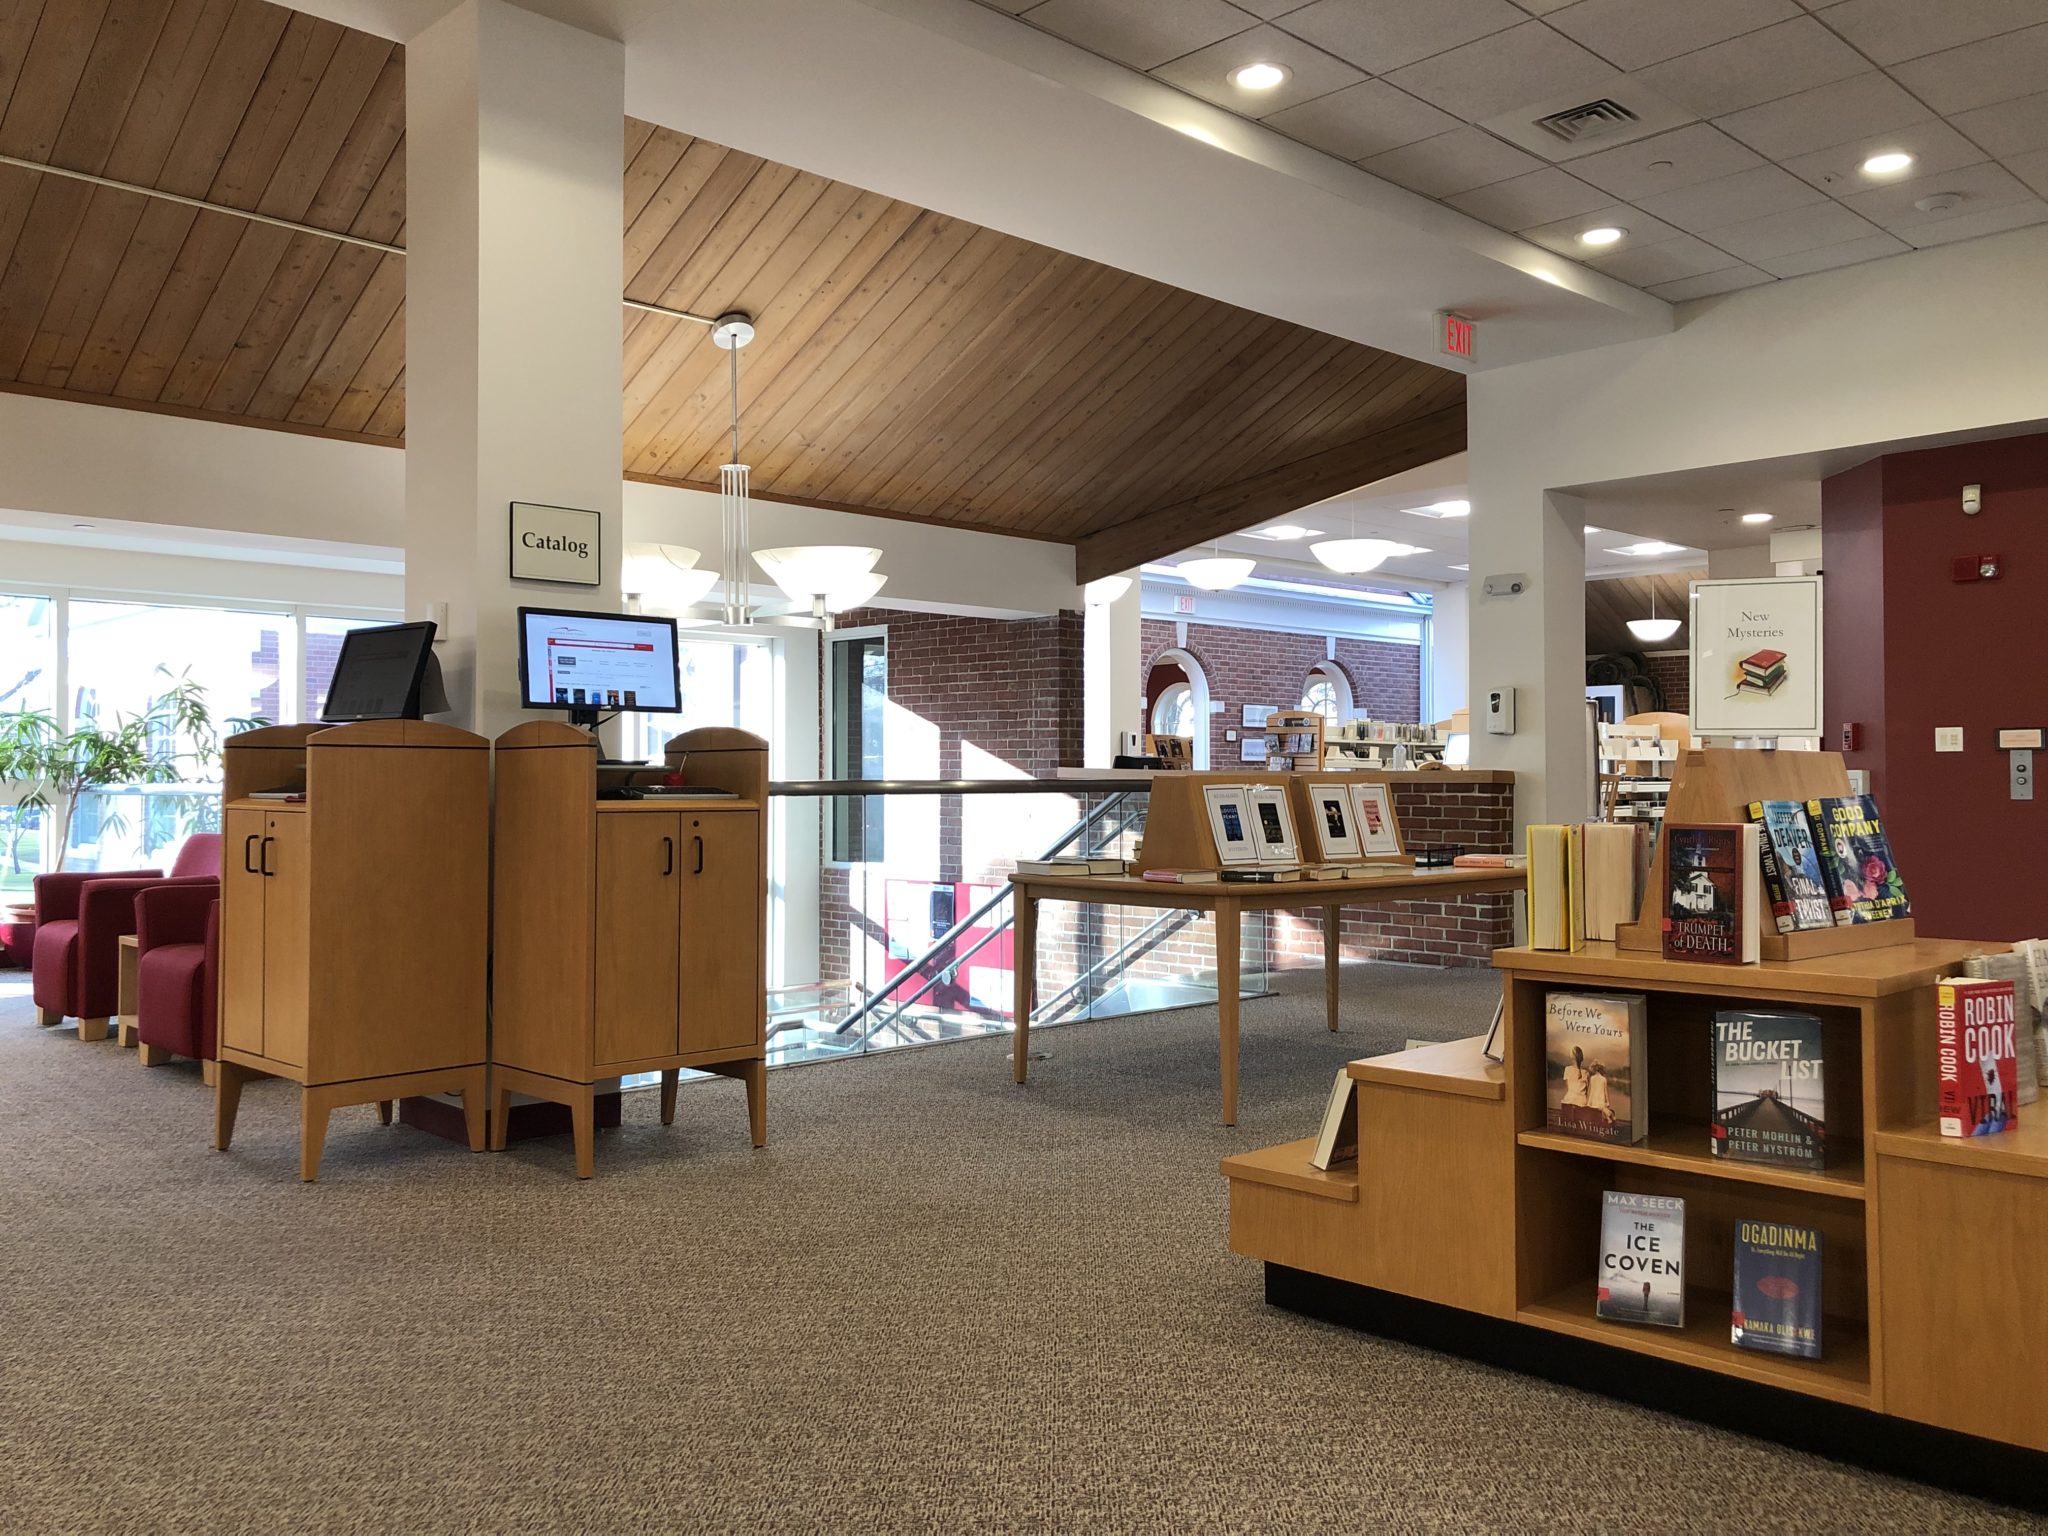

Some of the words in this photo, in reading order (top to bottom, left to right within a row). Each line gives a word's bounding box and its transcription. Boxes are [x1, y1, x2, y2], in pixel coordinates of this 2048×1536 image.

[1446, 318, 1472, 356] EXIT
[521, 531, 589, 559] Catalog
[1180, 596, 1193, 612] EXIT
[1741, 611, 1770, 622] New
[1727, 626, 1784, 641] Mysteries
[1832, 805, 1864, 822] GOOD
[1773, 828, 1813, 849] DEAVER
[1830, 819, 1881, 838] COMPANY
[1816, 823, 1830, 855] COMPANY
[1763, 854, 1777, 877] TWIST
[1791, 876, 1819, 895] FINAL
[1795, 899, 1827, 920] TWIST
[1678, 921, 1726, 937] TRUMPET
[1674, 938, 1684, 948] of
[1686, 936, 1727, 952] DEATH
[1549, 1003, 1583, 1021] Before
[1585, 1007, 1602, 1020] We
[1964, 994, 2015, 1026] ROBIN
[1565, 1020, 1591, 1034] Were
[1594, 1024, 1623, 1038] Yours
[1716, 1021, 1753, 1042] THE
[1939, 1003, 1957, 1045] ROBIN
[1725, 1040, 1803, 1062] BUCKET
[1964, 1023, 2016, 1063] COOK
[1781, 1059, 1824, 1080] LIST
[1940, 1047, 1958, 1082] COOK
[1967, 1090, 2017, 1126] VIRAL
[1557, 1117, 1577, 1129] Lisa
[1579, 1120, 1620, 1137] Wingate
[1728, 1126, 1758, 1139] PETER
[1762, 1131, 1802, 1144] MOHLIN
[1805, 1135, 1814, 1145] &
[1728, 1140, 1758, 1152] PETER
[1763, 1144, 1813, 1159] NYSTRÖM
[1607, 1194, 1637, 1206] MAX
[1642, 1197, 1684, 1211] SEECK
[1633, 1221, 1655, 1232] THE
[1626, 1234, 1661, 1252] ICE
[1741, 1222, 1817, 1252] OGADINMA
[1604, 1253, 1681, 1276] COVEN
